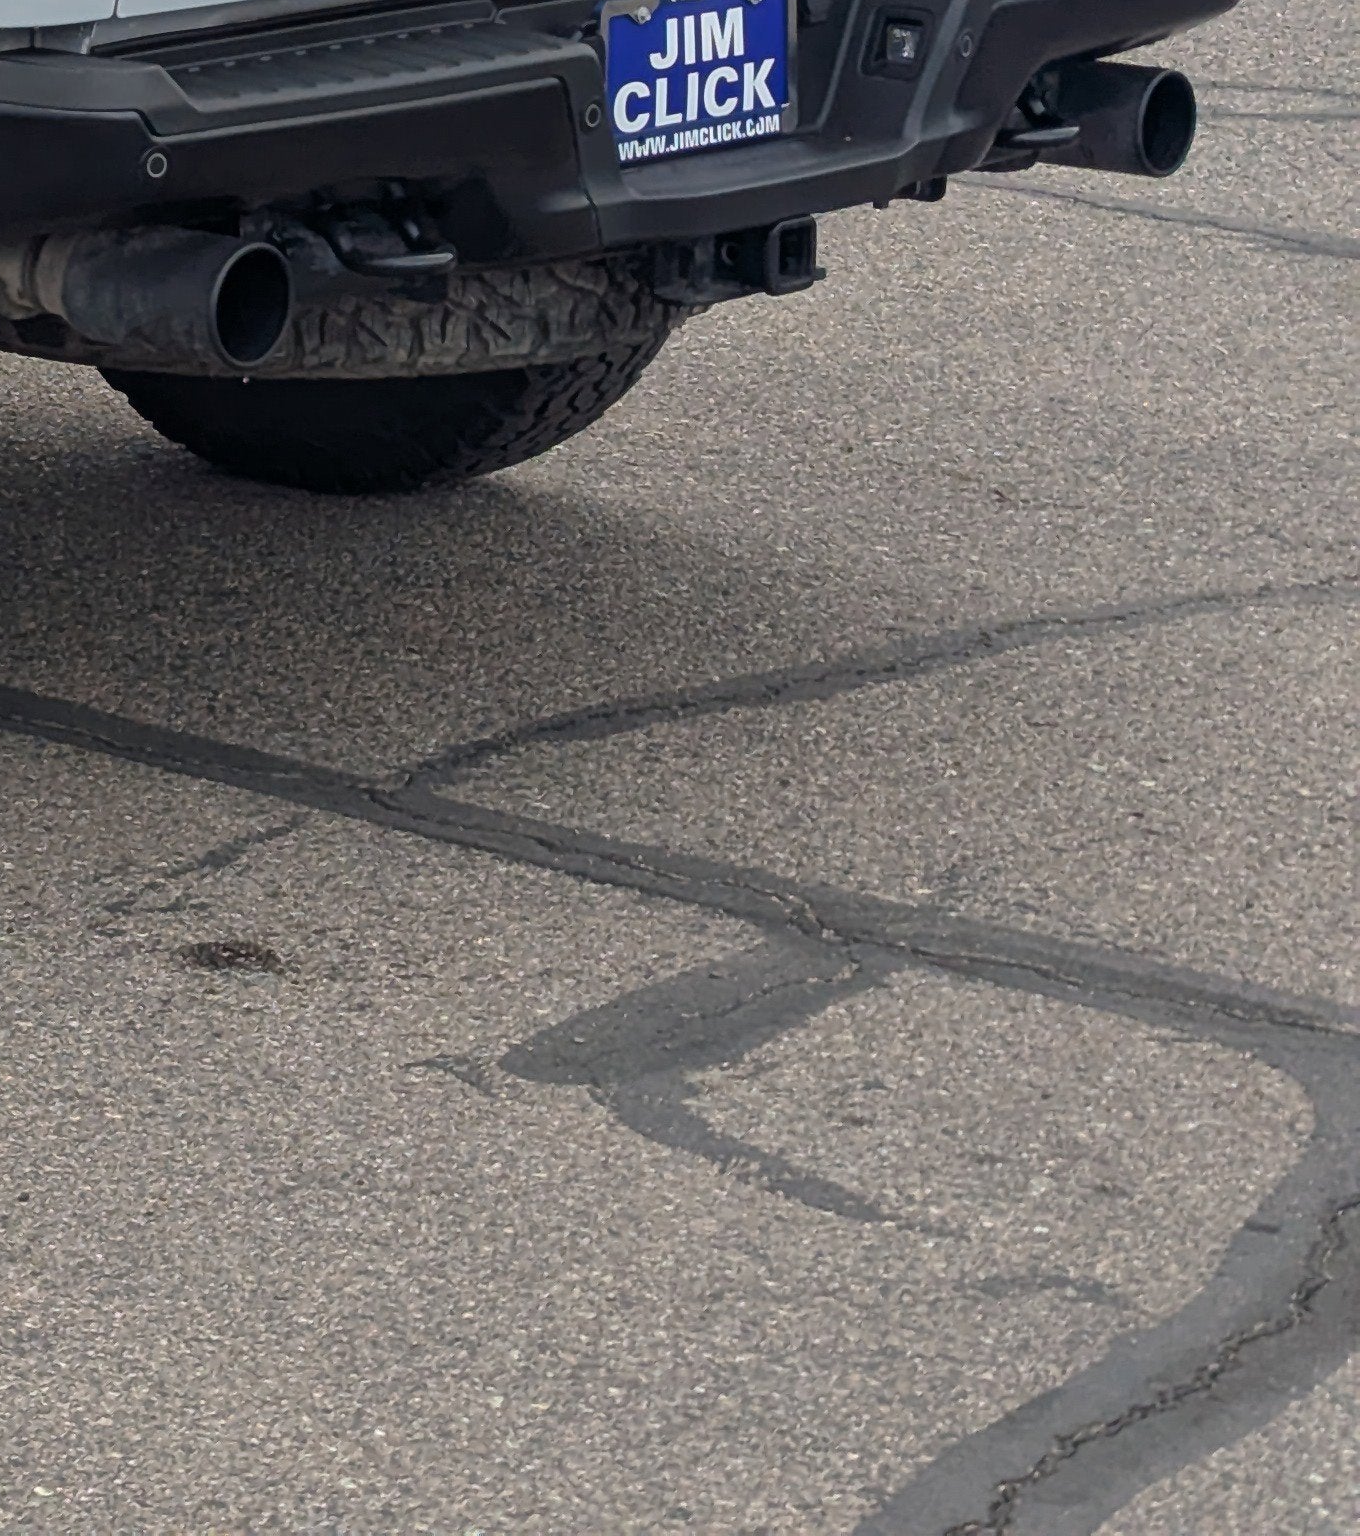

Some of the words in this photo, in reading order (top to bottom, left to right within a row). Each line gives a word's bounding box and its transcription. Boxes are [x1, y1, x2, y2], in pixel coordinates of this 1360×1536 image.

[649, 6, 745, 71] JIM
[612, 57, 777, 134] CLICK
[618, 114, 779, 161] WWW.JIMCLICK.COM
